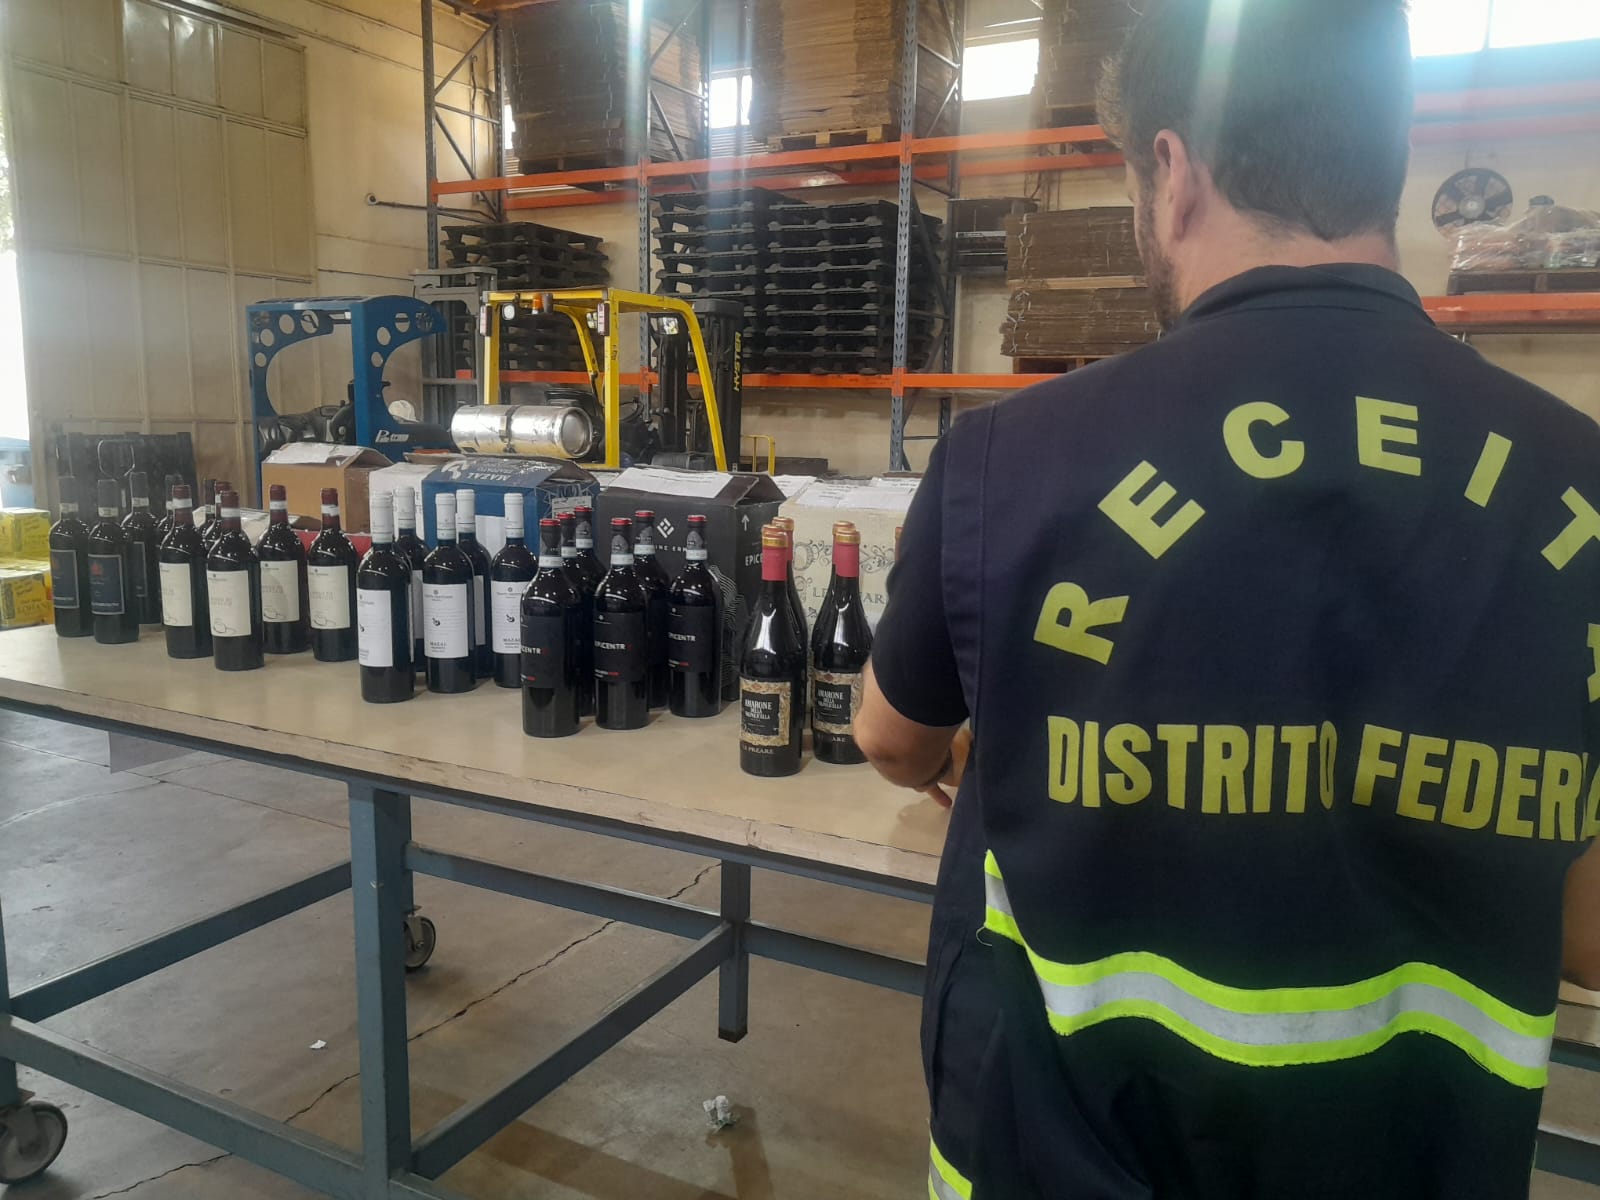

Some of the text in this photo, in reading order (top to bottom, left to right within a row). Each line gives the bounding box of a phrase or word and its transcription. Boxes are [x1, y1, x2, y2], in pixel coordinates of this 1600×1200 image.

[733, 331, 741, 392] HYSTER
[1033, 395, 1600, 703] RECEIT
[1048, 715, 1600, 842] DISTRITO FEDER
